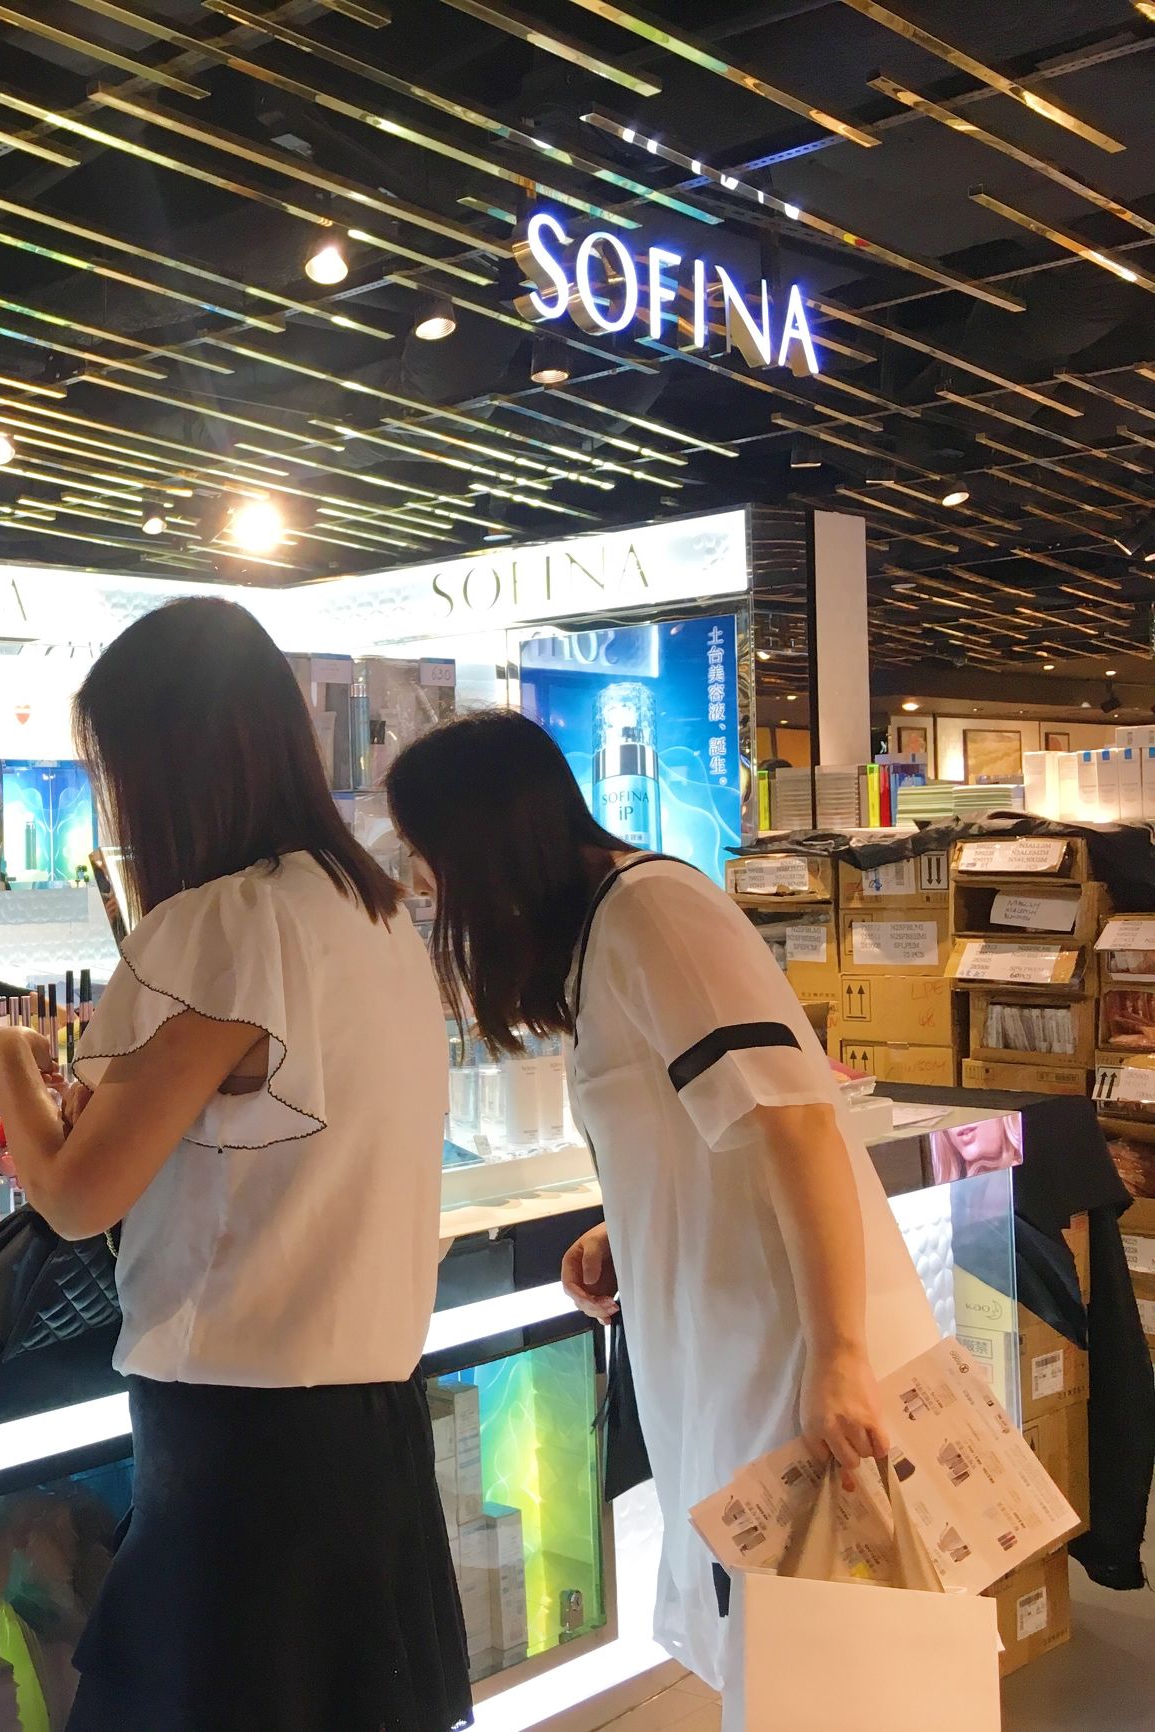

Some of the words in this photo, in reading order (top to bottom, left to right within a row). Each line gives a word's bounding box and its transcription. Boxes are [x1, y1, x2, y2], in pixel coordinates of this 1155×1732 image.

[527, 212, 819, 375] SOFINA
[432, 543, 649, 617] SOFINA
[431, 666, 451, 681] 630
[707, 625, 728, 786] 土台美容液、誕生。
[601, 790, 650, 806] SOFINA
[619, 805, 634, 821] iP
